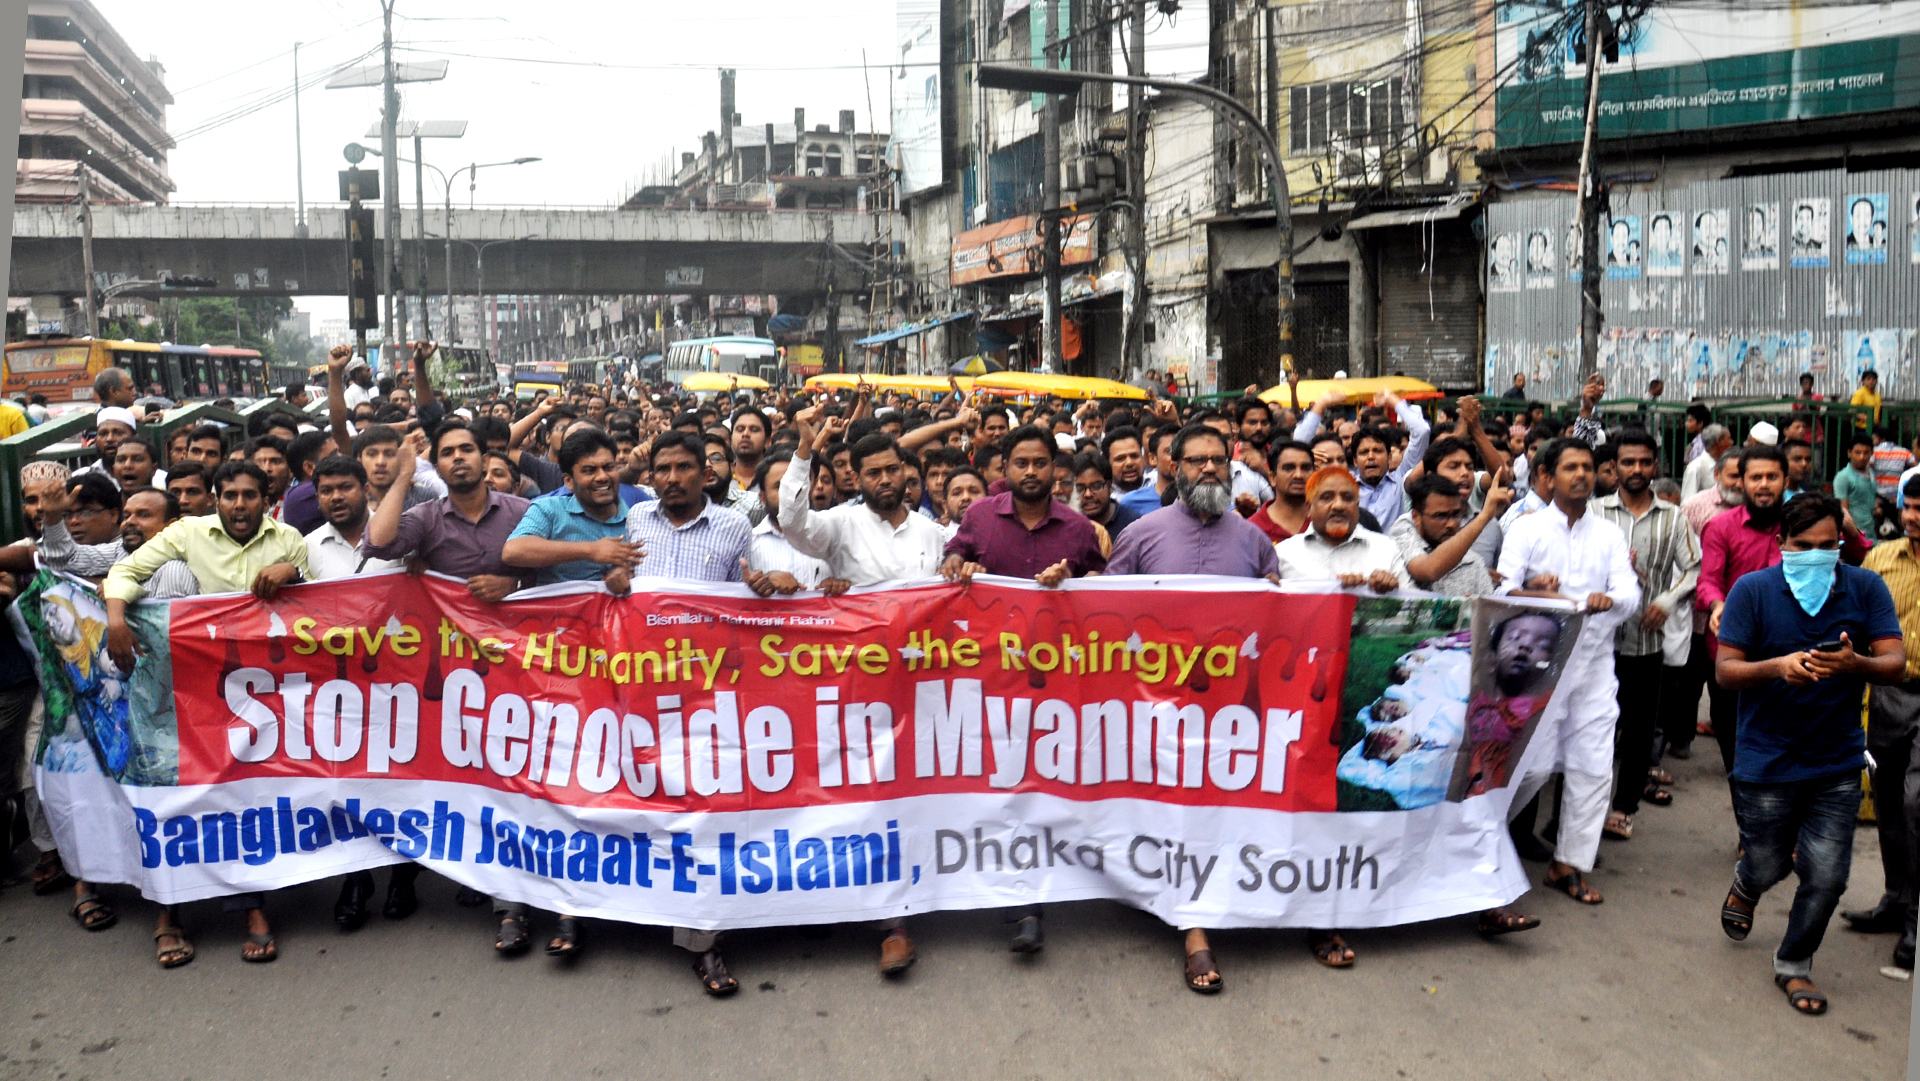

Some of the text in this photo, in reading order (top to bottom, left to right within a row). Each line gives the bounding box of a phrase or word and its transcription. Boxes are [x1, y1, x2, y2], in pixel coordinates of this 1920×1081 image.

[293, 616, 423, 657] Save
[440, 617, 505, 664] the
[760, 634, 890, 677] Save
[904, 629, 981, 672] the
[1000, 630, 1238, 687] Rohingya
[789, 616, 835, 626] Rahim
[225, 667, 1302, 797] Stop Genocide in Myanmer
[134, 796, 465, 870] Bangladesh
[935, 827, 1105, 874] Dhaka
[1128, 835, 1218, 901] City
[1238, 843, 1379, 893] South
